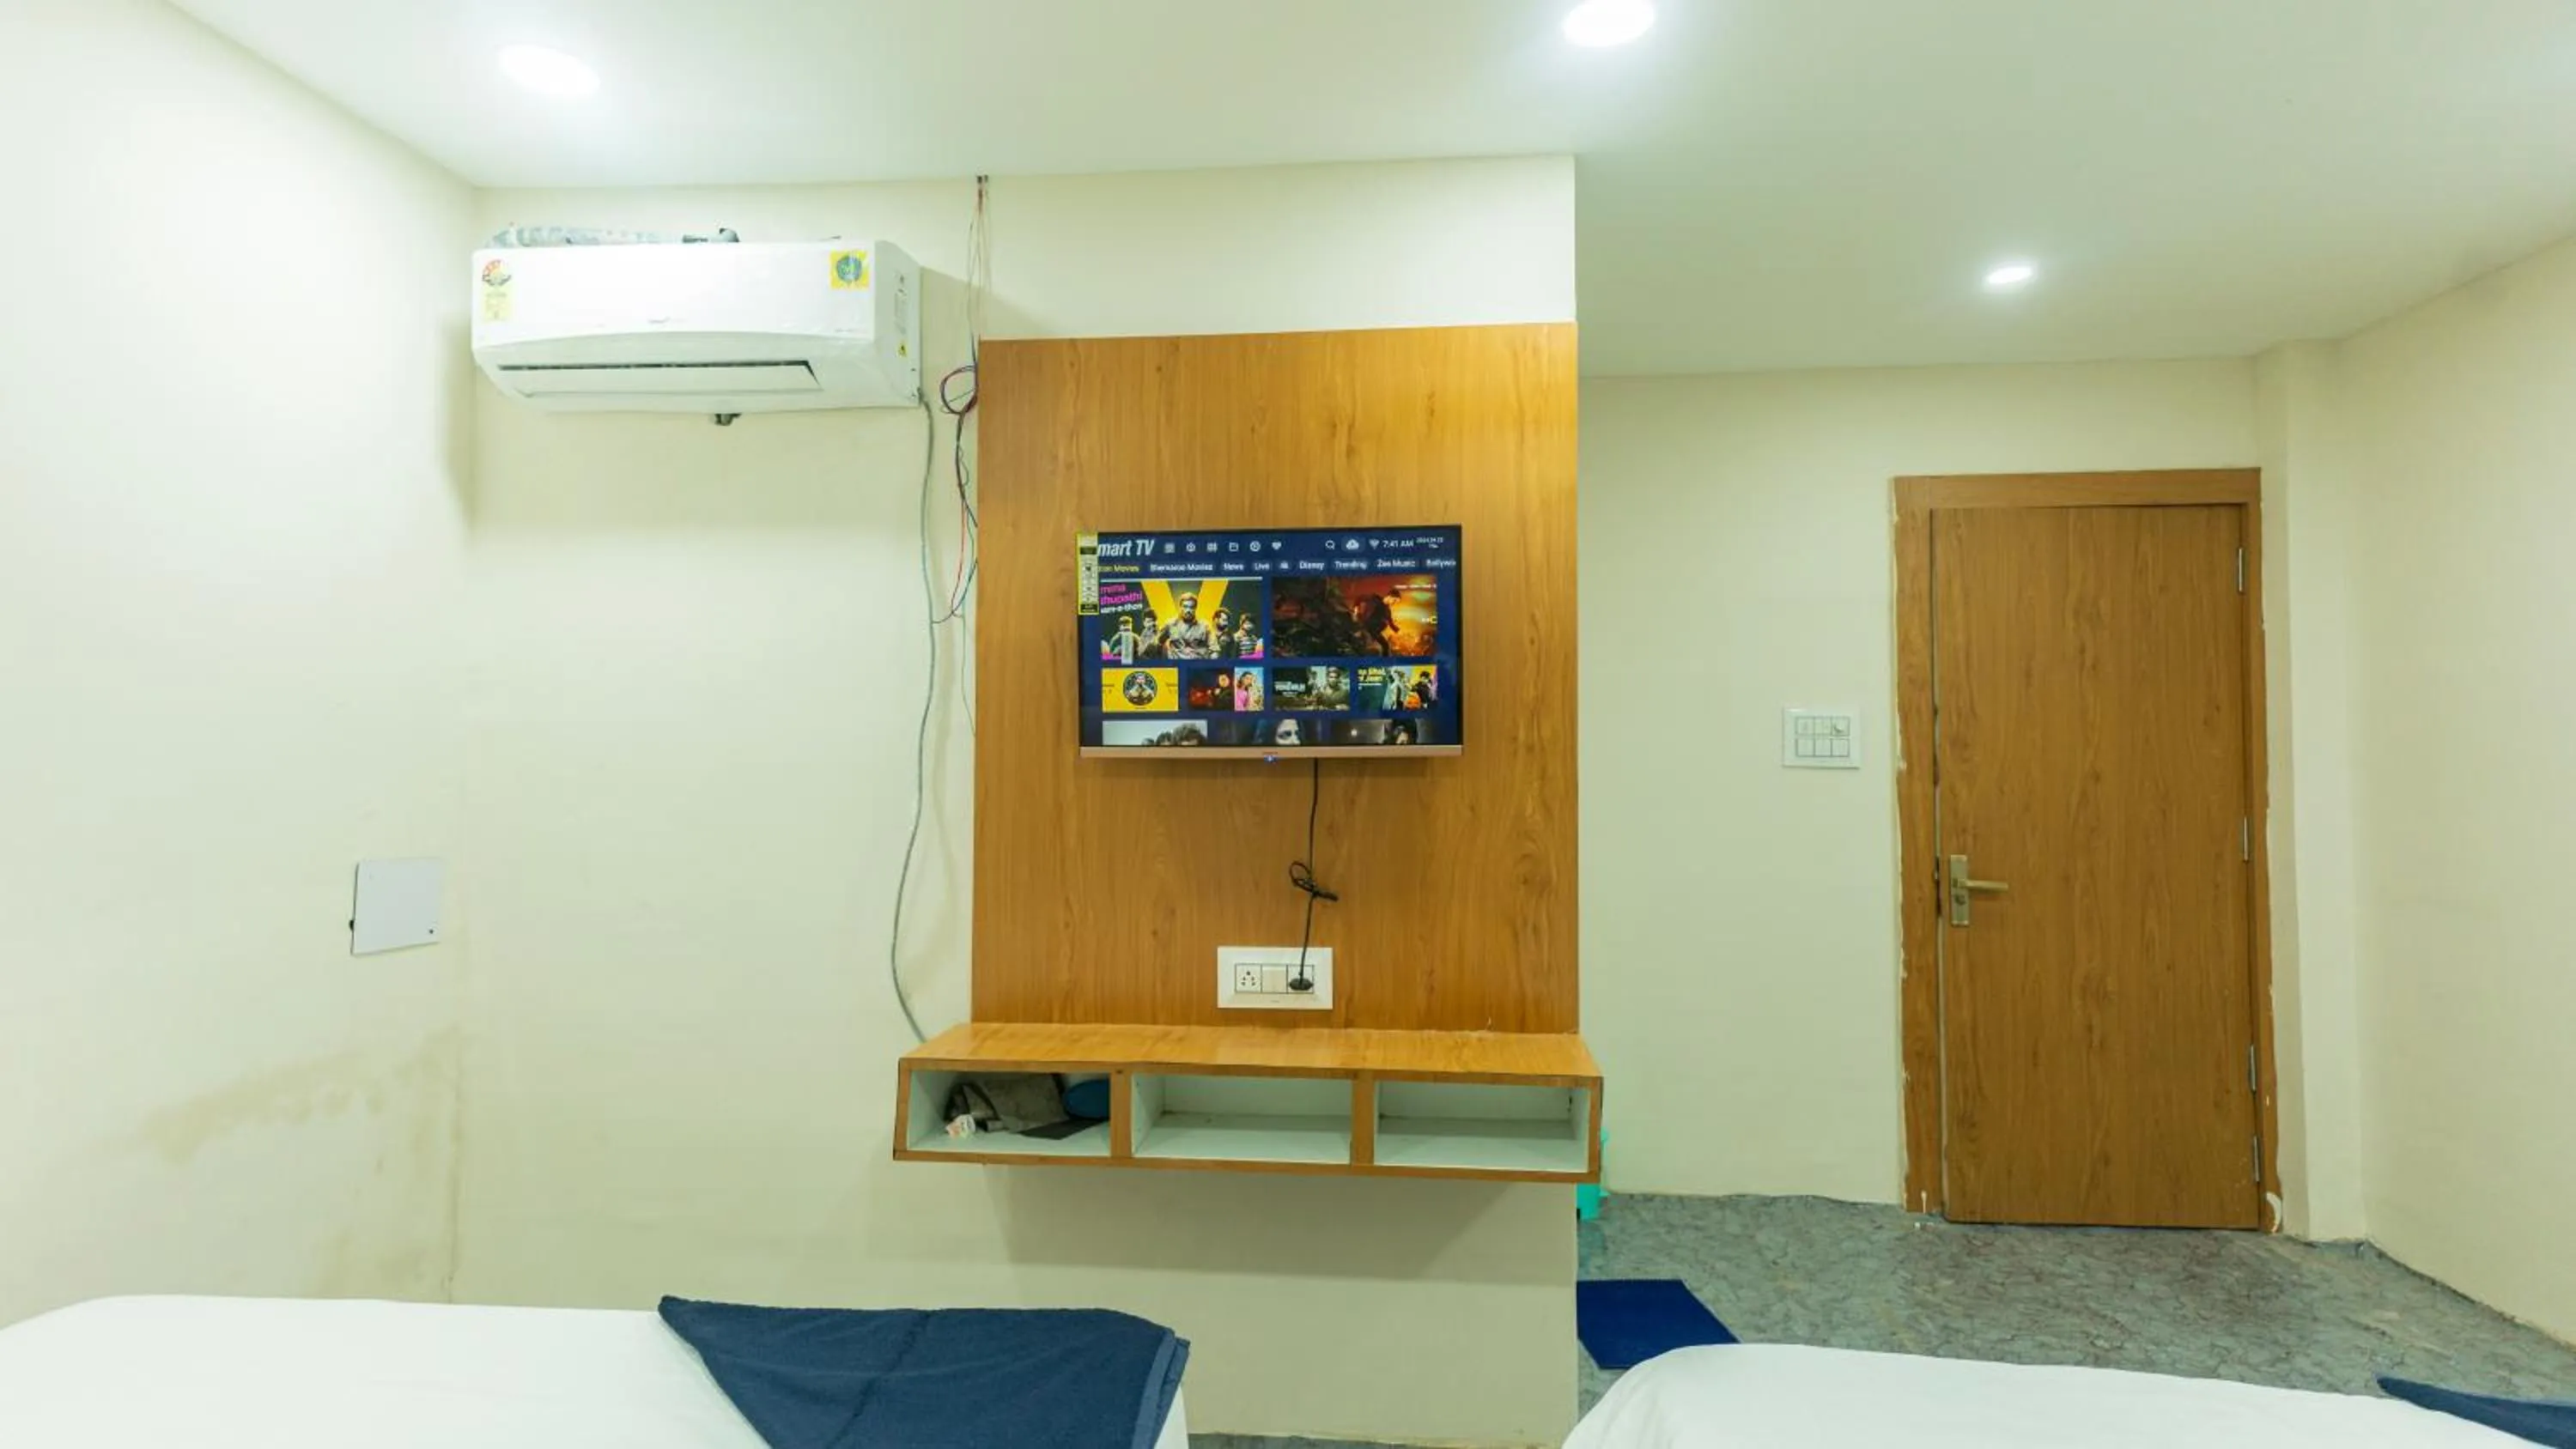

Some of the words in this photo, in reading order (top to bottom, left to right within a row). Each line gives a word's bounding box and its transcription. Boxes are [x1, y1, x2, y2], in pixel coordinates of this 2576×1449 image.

[1097, 540, 1133, 556] mart
[1135, 538, 1155, 556] TV
[1382, 540, 1399, 549] 7:41
[1400, 539, 1414, 548] AM
[1224, 561, 1244, 571] News
[1299, 561, 1325, 571] Disney
[1334, 561, 1368, 570] Trending
